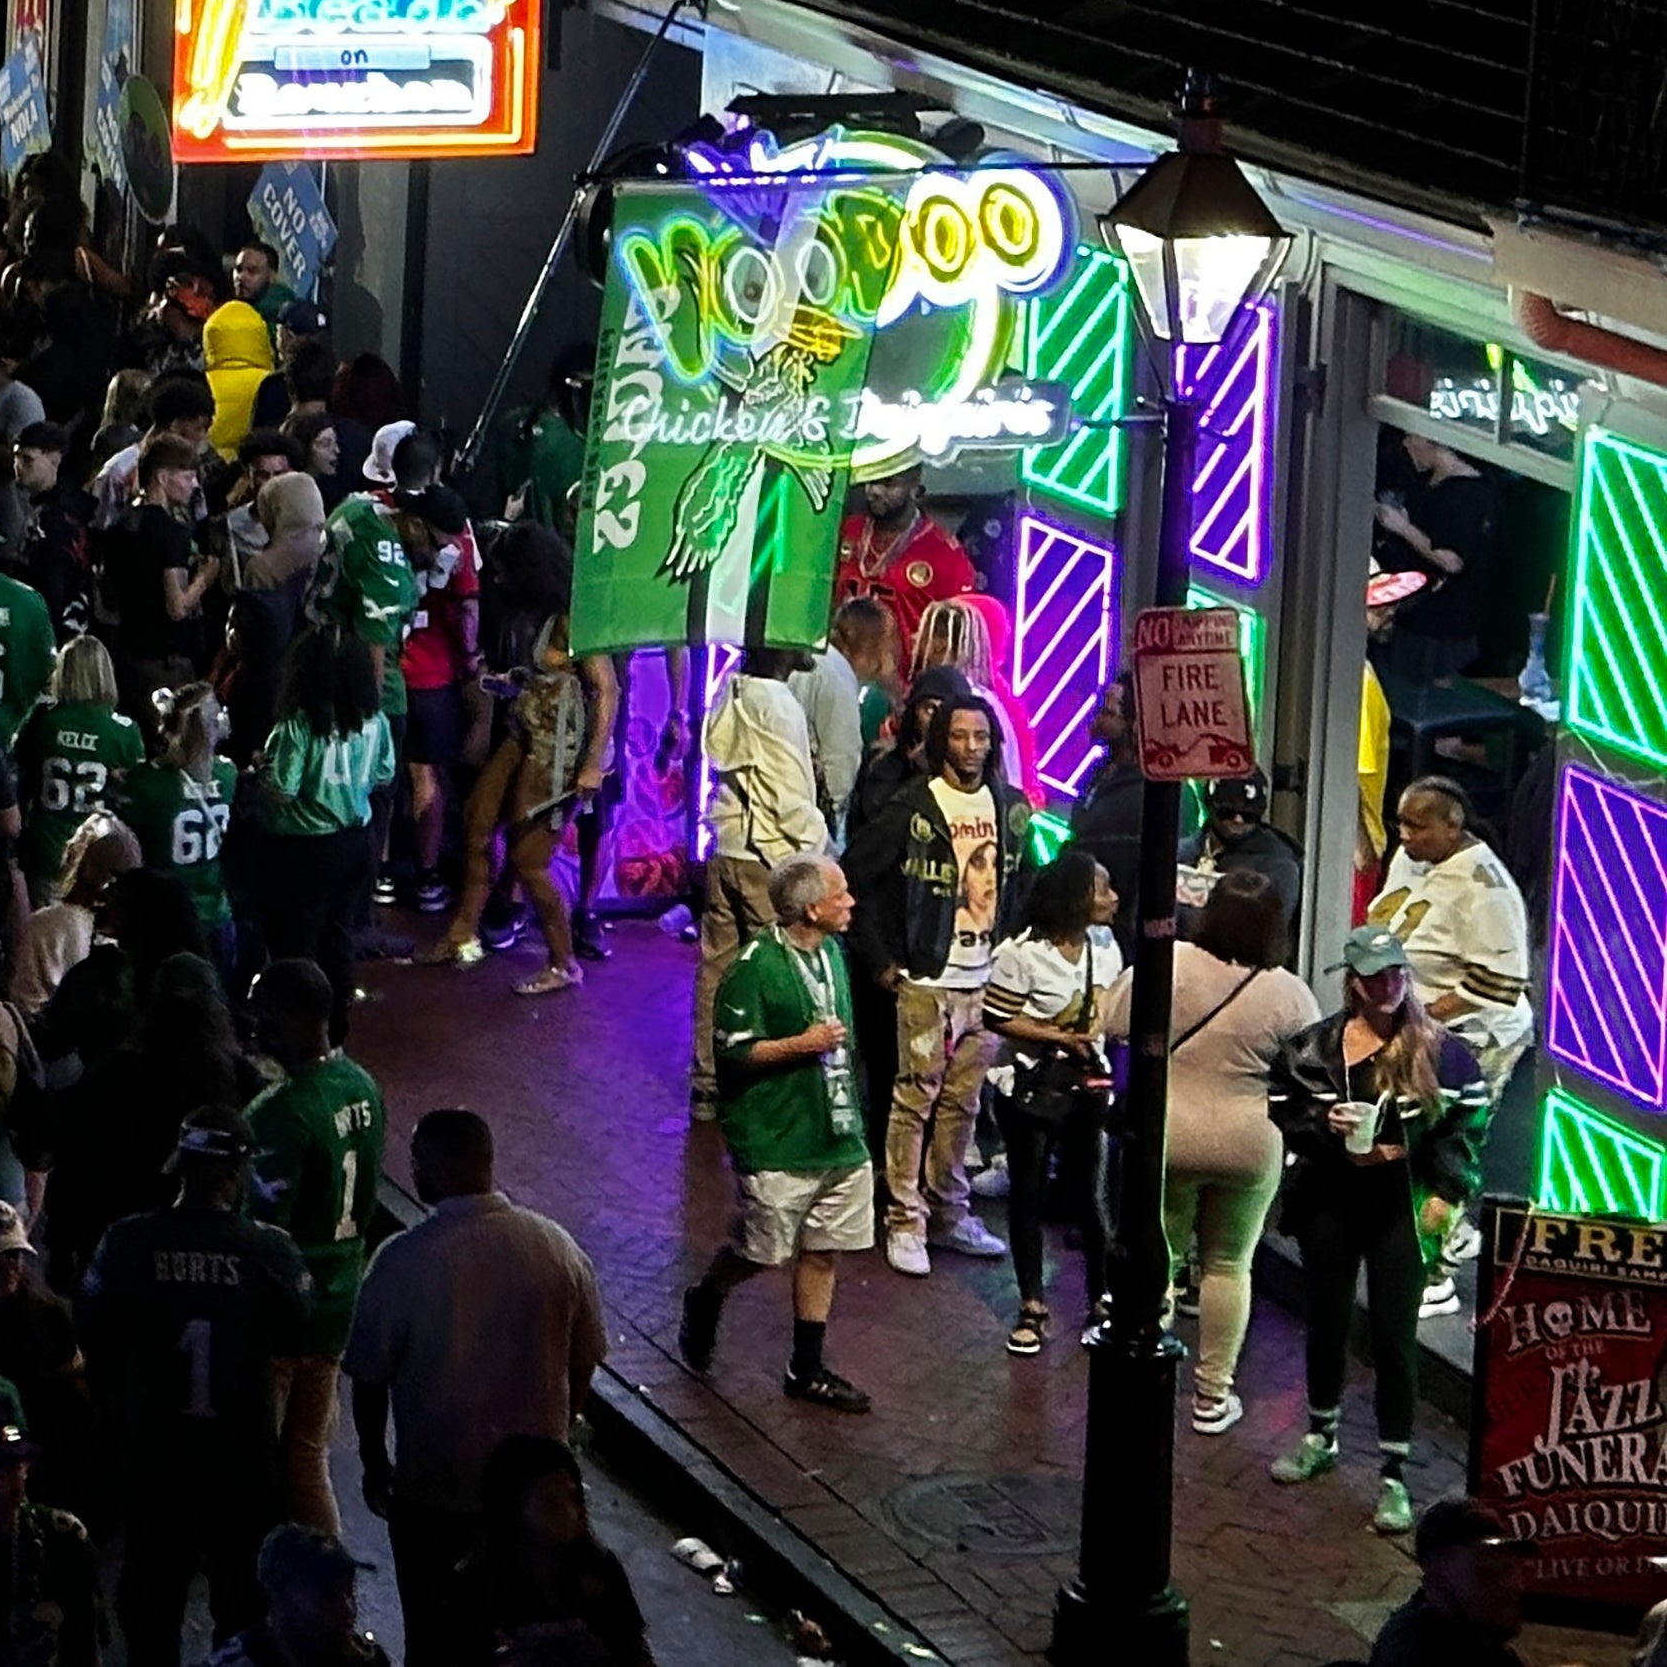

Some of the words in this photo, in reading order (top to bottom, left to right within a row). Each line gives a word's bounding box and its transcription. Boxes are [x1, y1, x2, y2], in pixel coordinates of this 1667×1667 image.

[340, 48, 369, 65] on
[263, 182, 307, 280] COVER
[283, 186, 307, 235] NO
[621, 392, 793, 444] Chicken
[1136, 617, 1171, 649] NO
[1161, 663, 1220, 692] FIRE
[1160, 699, 1229, 729] LANE
[40, 755, 109, 814] 62
[333, 1149, 359, 1244] 1
[153, 1249, 243, 1286] HURTS
[178, 1317, 218, 1420] 1
